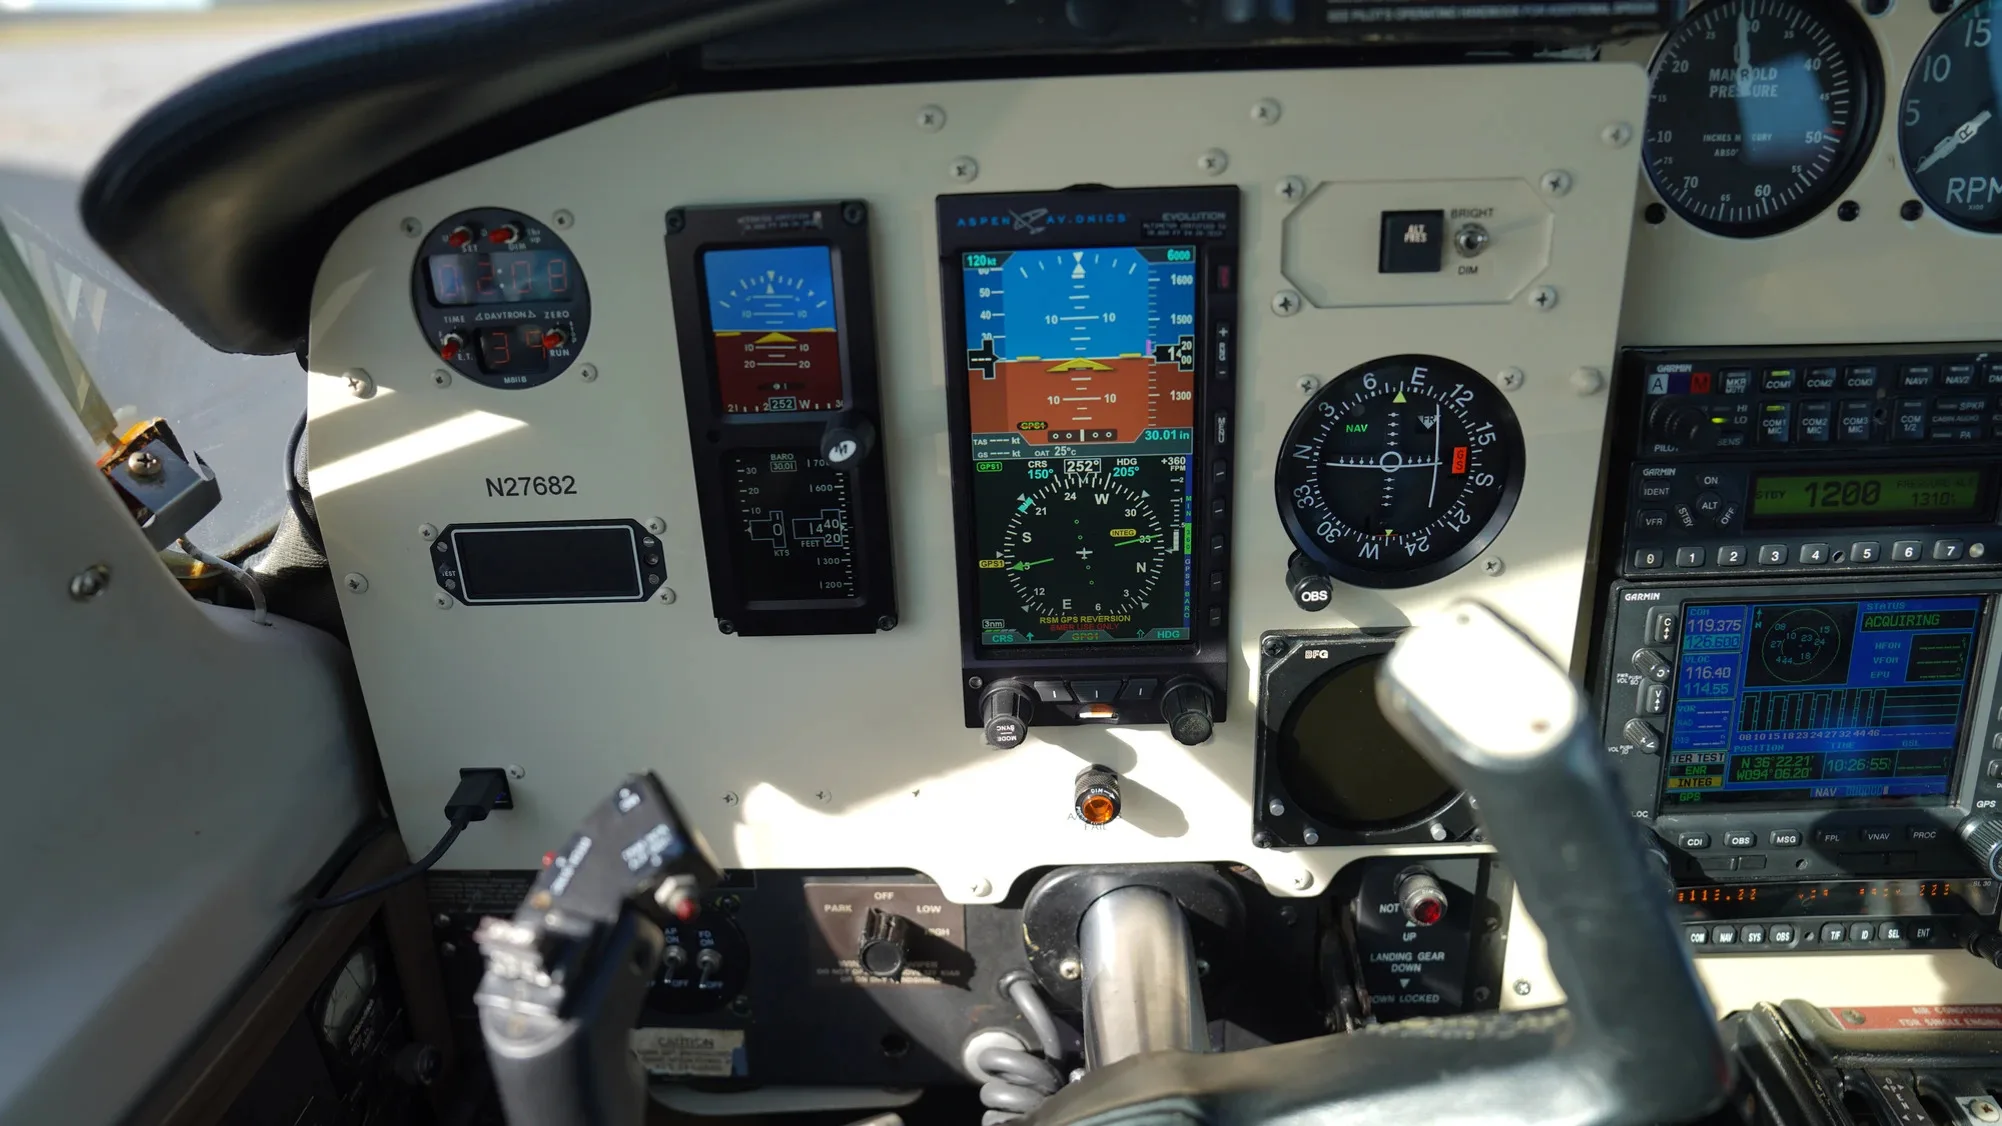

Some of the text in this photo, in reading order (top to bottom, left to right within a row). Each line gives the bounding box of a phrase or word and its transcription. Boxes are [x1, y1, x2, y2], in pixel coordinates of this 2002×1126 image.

[1965, 19, 1992, 47] 15
[1672, 60, 1689, 74] 20
[1803, 58, 1822, 72] 40
[1923, 54, 1951, 83] 10
[1709, 68, 1778, 81] MANOLD
[1709, 84, 1778, 98] PREURE
[1657, 130, 1672, 143] 10
[1805, 131, 1822, 144] 50
[1683, 176, 1699, 189] 70
[1754, 184, 1772, 198] 60
[1162, 212, 1226, 221] EVOLUTION
[1451, 208, 1493, 219] BRIGHT
[957, 216, 1010, 227] ASPEN
[1167, 249, 1191, 261] 6000
[1458, 266, 1478, 275] DIM
[1171, 274, 1193, 285] 1600
[980, 288, 990, 297] 50
[444, 315, 465, 324] TIME
[484, 311, 527, 320] DAVTRON
[544, 311, 570, 319] ZERO
[980, 310, 991, 320] 40
[1045, 315, 1058, 324] 10
[1103, 313, 1116, 323] 10
[1171, 314, 1193, 324] 1500
[550, 349, 569, 357] RUN
[1657, 364, 1692, 372] GARMIN
[1411, 366, 1428, 386] E
[1945, 376, 1969, 384] NAV2
[1363, 373, 1377, 389] 6
[1766, 381, 1791, 389] COM1
[1807, 379, 1833, 387] COM2
[1905, 377, 1928, 385] NAV1
[1104, 394, 1116, 403] 10
[1170, 390, 1191, 400] 1300
[1450, 383, 1474, 408] 12
[1048, 396, 1060, 405] 10
[1802, 418, 1828, 426] COM2
[1843, 417, 1868, 425] COM3
[1346, 424, 1368, 433] NAV
[1145, 430, 1190, 440] 30.01 in
[1476, 422, 1496, 446] 15
[746, 467, 757, 475] 30
[1643, 468, 1676, 476] GARMIN
[485, 475, 577, 497] N27682
[1064, 492, 1077, 501] 24
[1293, 484, 1314, 509] 33
[1644, 488, 1670, 496] IDENT
[1805, 480, 1881, 508] 1200
[1701, 502, 1718, 510] ALT
[1125, 508, 1137, 517] 30
[1721, 507, 1736, 525] OFF
[1448, 508, 1471, 533] 21
[1646, 518, 1663, 526] VFR
[1678, 507, 1694, 528] STBY
[1316, 521, 1342, 544] 30
[1405, 535, 1430, 557] 24
[1301, 590, 1328, 602] OBS
[1625, 593, 1660, 601] GARMIN
[1867, 602, 1905, 610] STATUS
[1039, 616, 1059, 624] RSM
[1081, 615, 1131, 623] REVERSION
[1865, 614, 1940, 627] ACQUIRING
[1688, 619, 1741, 632] 119.375
[992, 634, 1014, 643] CRS
[1157, 630, 1180, 639] HDG
[1304, 650, 1329, 659] BFG
[1686, 666, 1731, 679] 116.40
[1684, 682, 1729, 695] 114.55
[1672, 753, 1724, 763] TER TEST
[1685, 766, 1707, 775] ENR
[1678, 778, 1712, 787] INTEG
[1680, 792, 1700, 801] GPS
[1687, 838, 1702, 846] CDI
[874, 892, 894, 900] OFF
[824, 904, 853, 912] PARK
[917, 905, 942, 913] LOW
[1379, 903, 1400, 913] NOT
[1403, 933, 1416, 941] UP
[1776, 932, 1789, 941] OBS
[1888, 929, 1899, 938] SEL
[1917, 928, 1930, 937] ENT
[1691, 933, 1705, 942] COM
[1720, 933, 1733, 942] NAV
[1749, 933, 1761, 942] SYS
[1371, 952, 1444, 961] LANDING GEAR
[1391, 964, 1421, 972] DOWN
[1369, 994, 1439, 1003] OWN LOCKED
